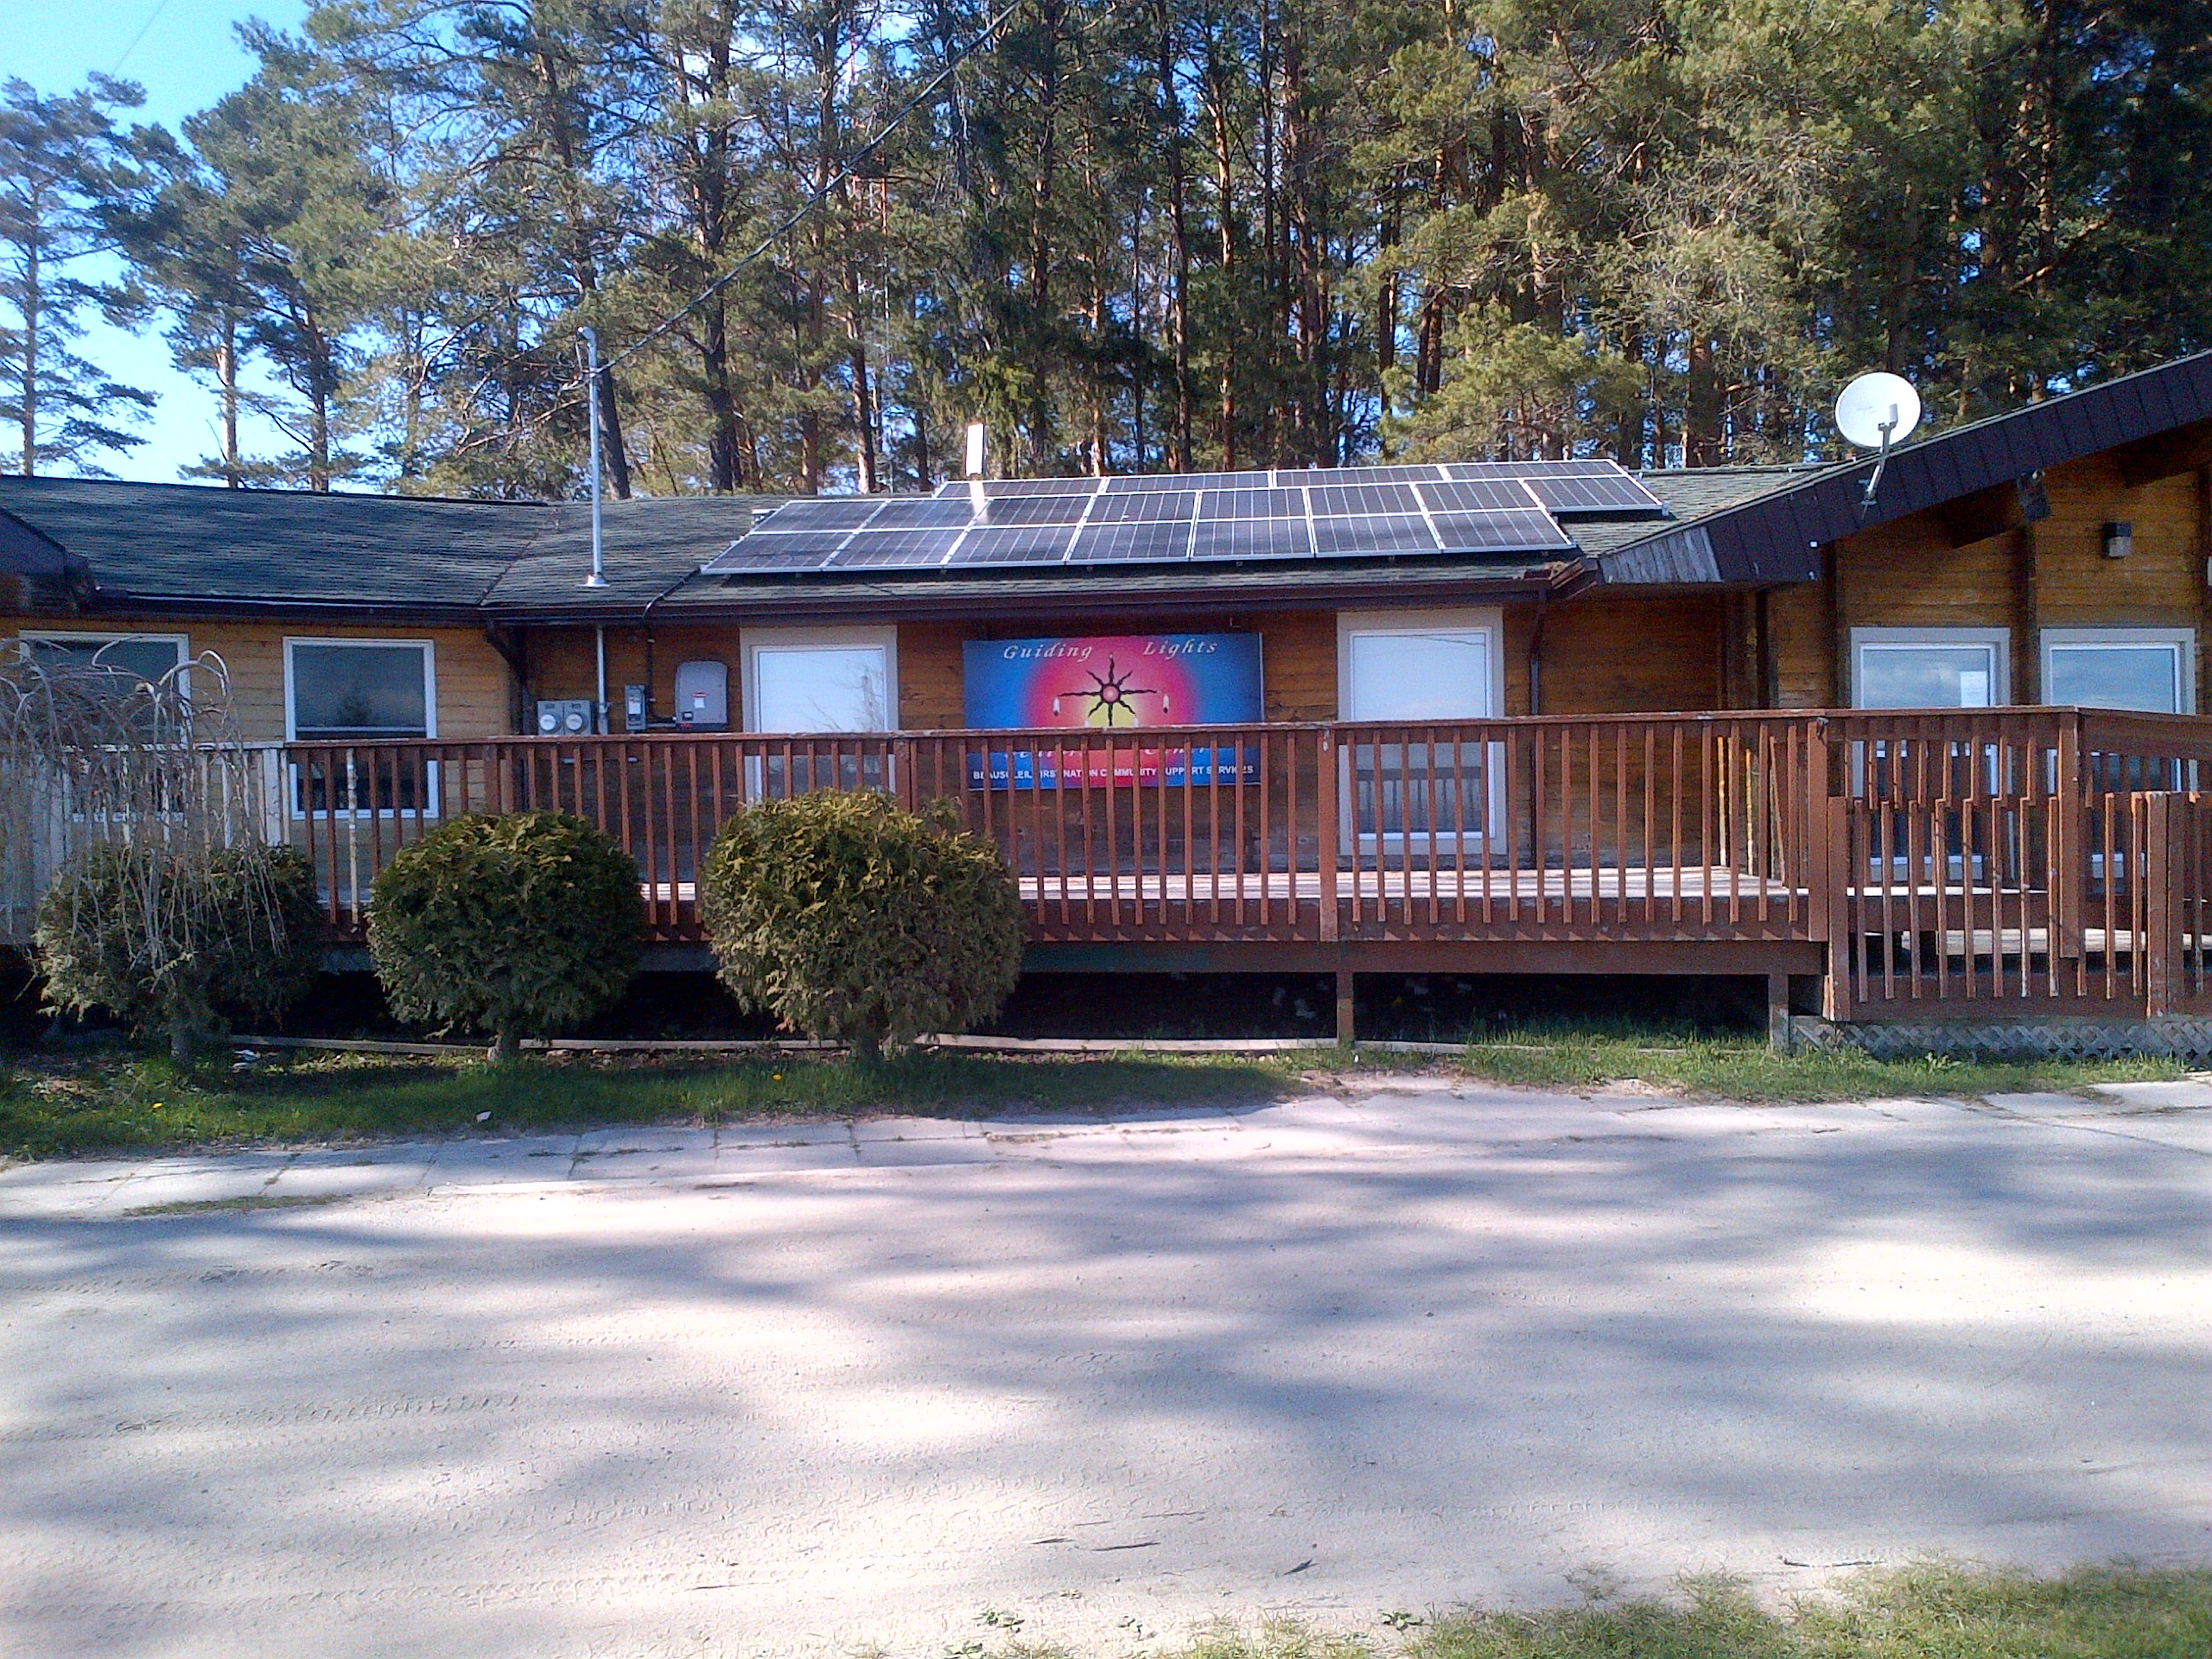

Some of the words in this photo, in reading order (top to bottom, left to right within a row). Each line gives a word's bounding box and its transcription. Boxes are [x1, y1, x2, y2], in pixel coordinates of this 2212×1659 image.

[1003, 642, 1093, 663] Guiding
[1142, 638, 1218, 661] Lights
[973, 770, 1033, 780] BEUSEIL
[1064, 768, 1098, 778] NATN
[1100, 766, 1157, 777] CMMUITY
[1162, 766, 1204, 776] UPPRT
[1206, 765, 1253, 775] SRVIS
